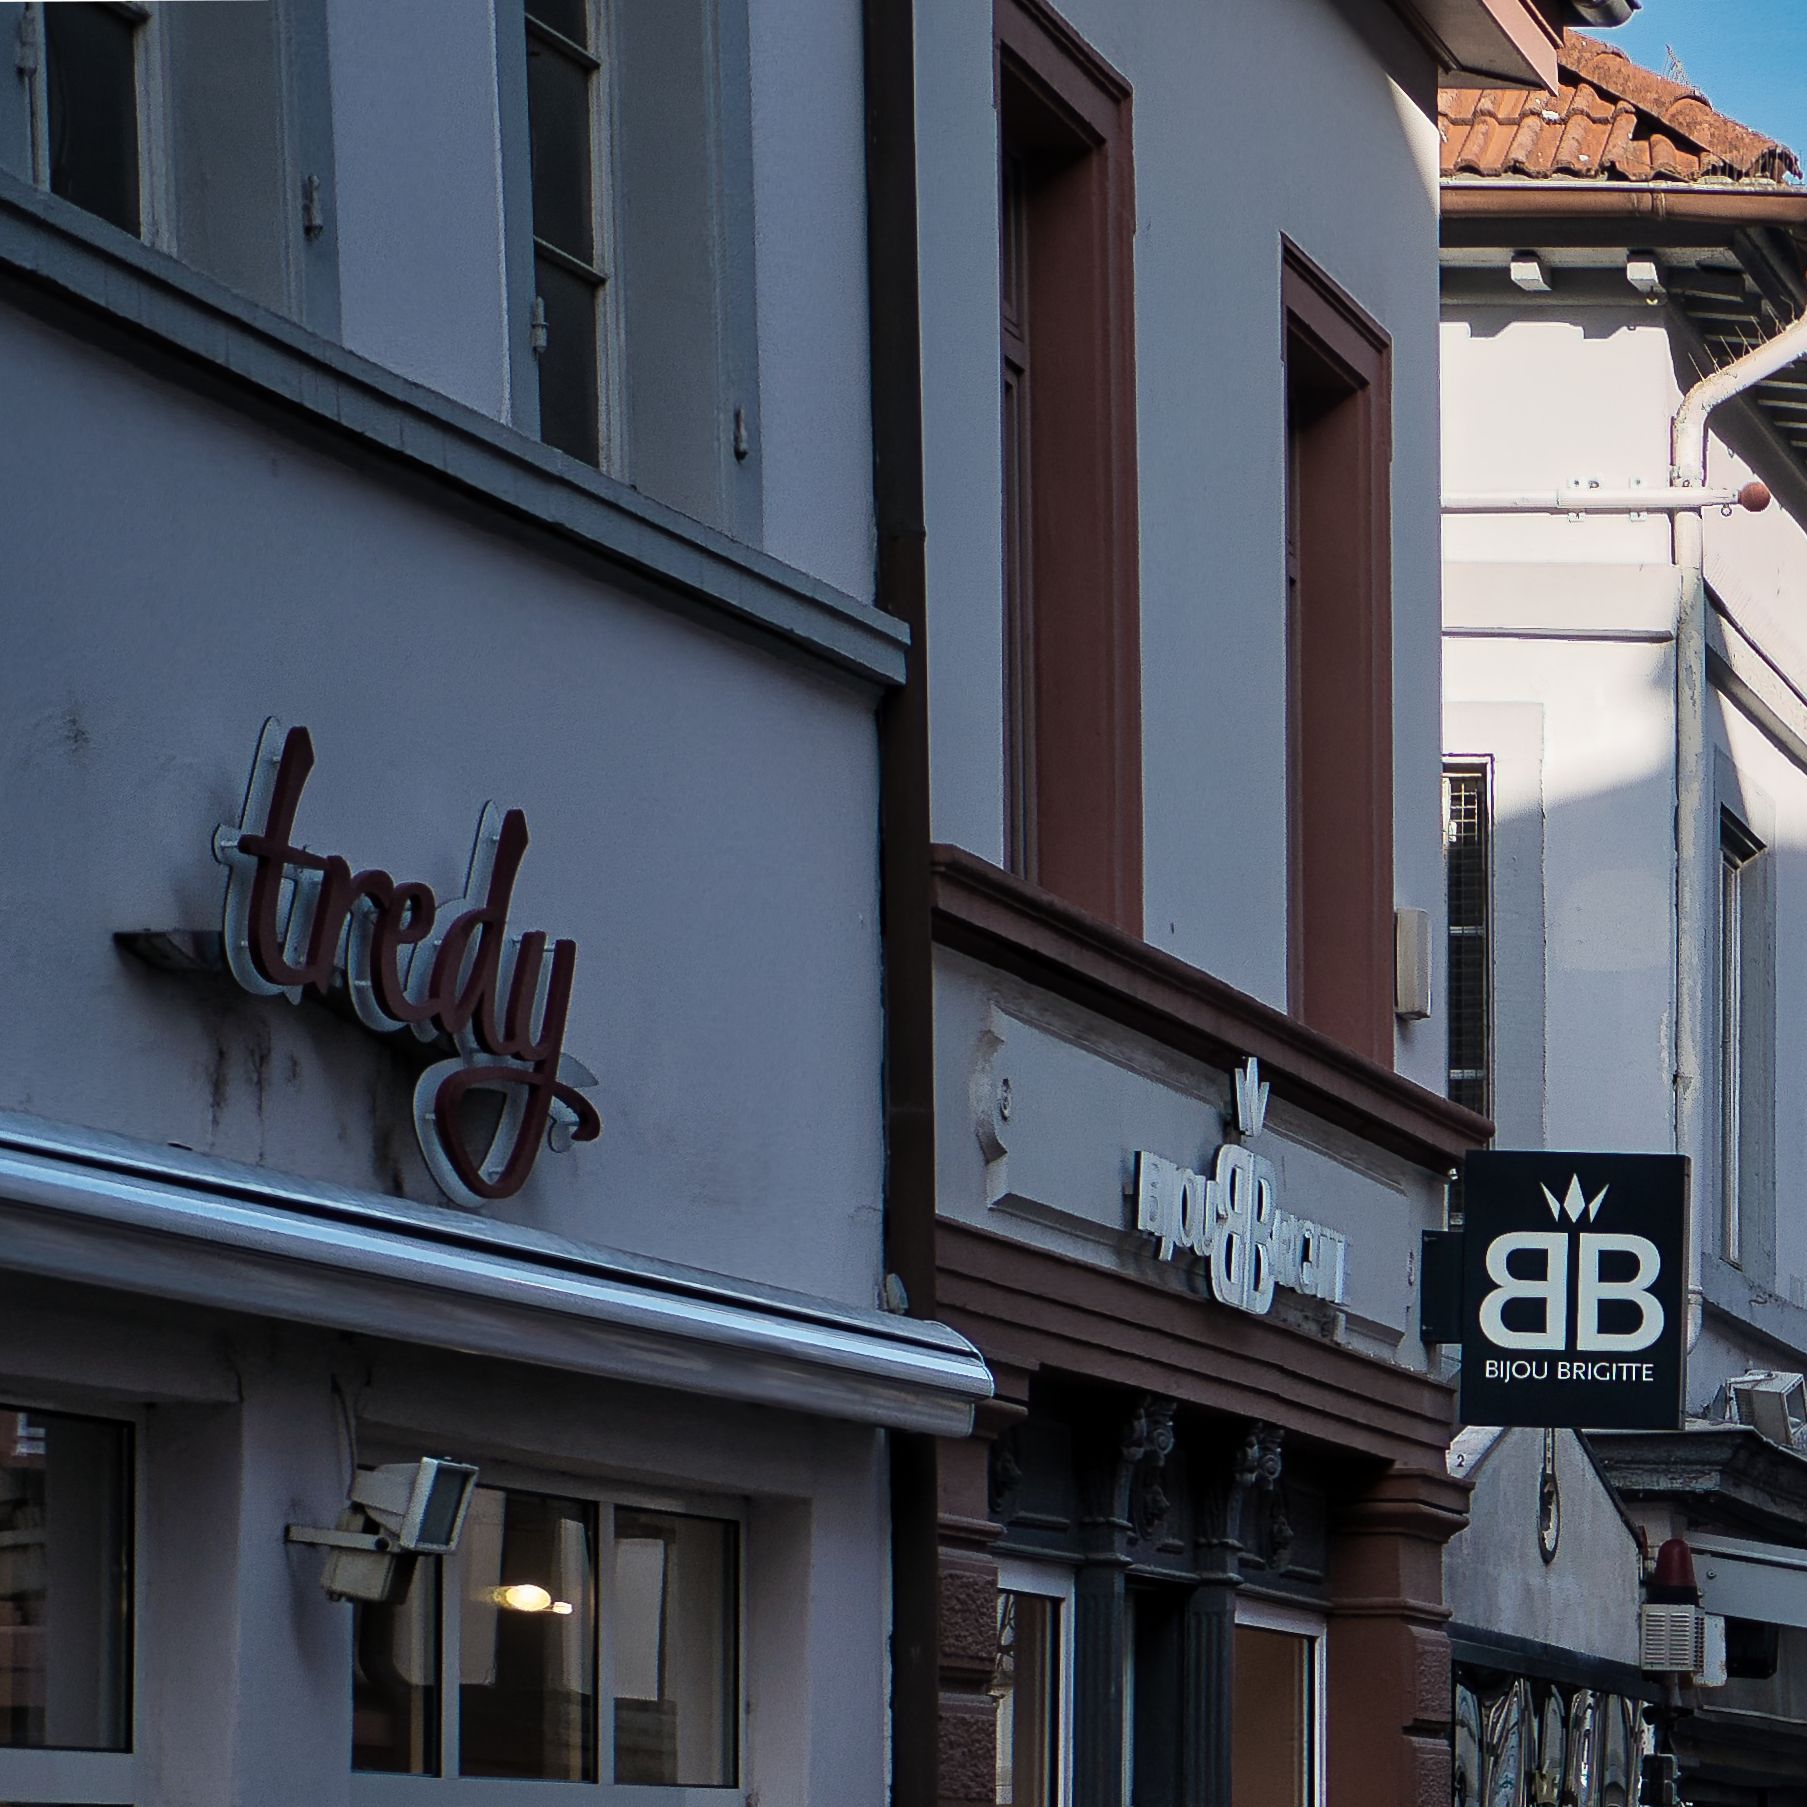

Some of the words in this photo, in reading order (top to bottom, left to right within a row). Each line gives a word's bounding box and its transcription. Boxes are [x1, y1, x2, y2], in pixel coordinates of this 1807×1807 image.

[218, 720, 602, 1202] tredy
[1485, 1360, 1548, 1383] BIJOU
[1557, 1361, 1654, 1382] BRIGITTE
[1456, 1453, 1466, 1468] 2
